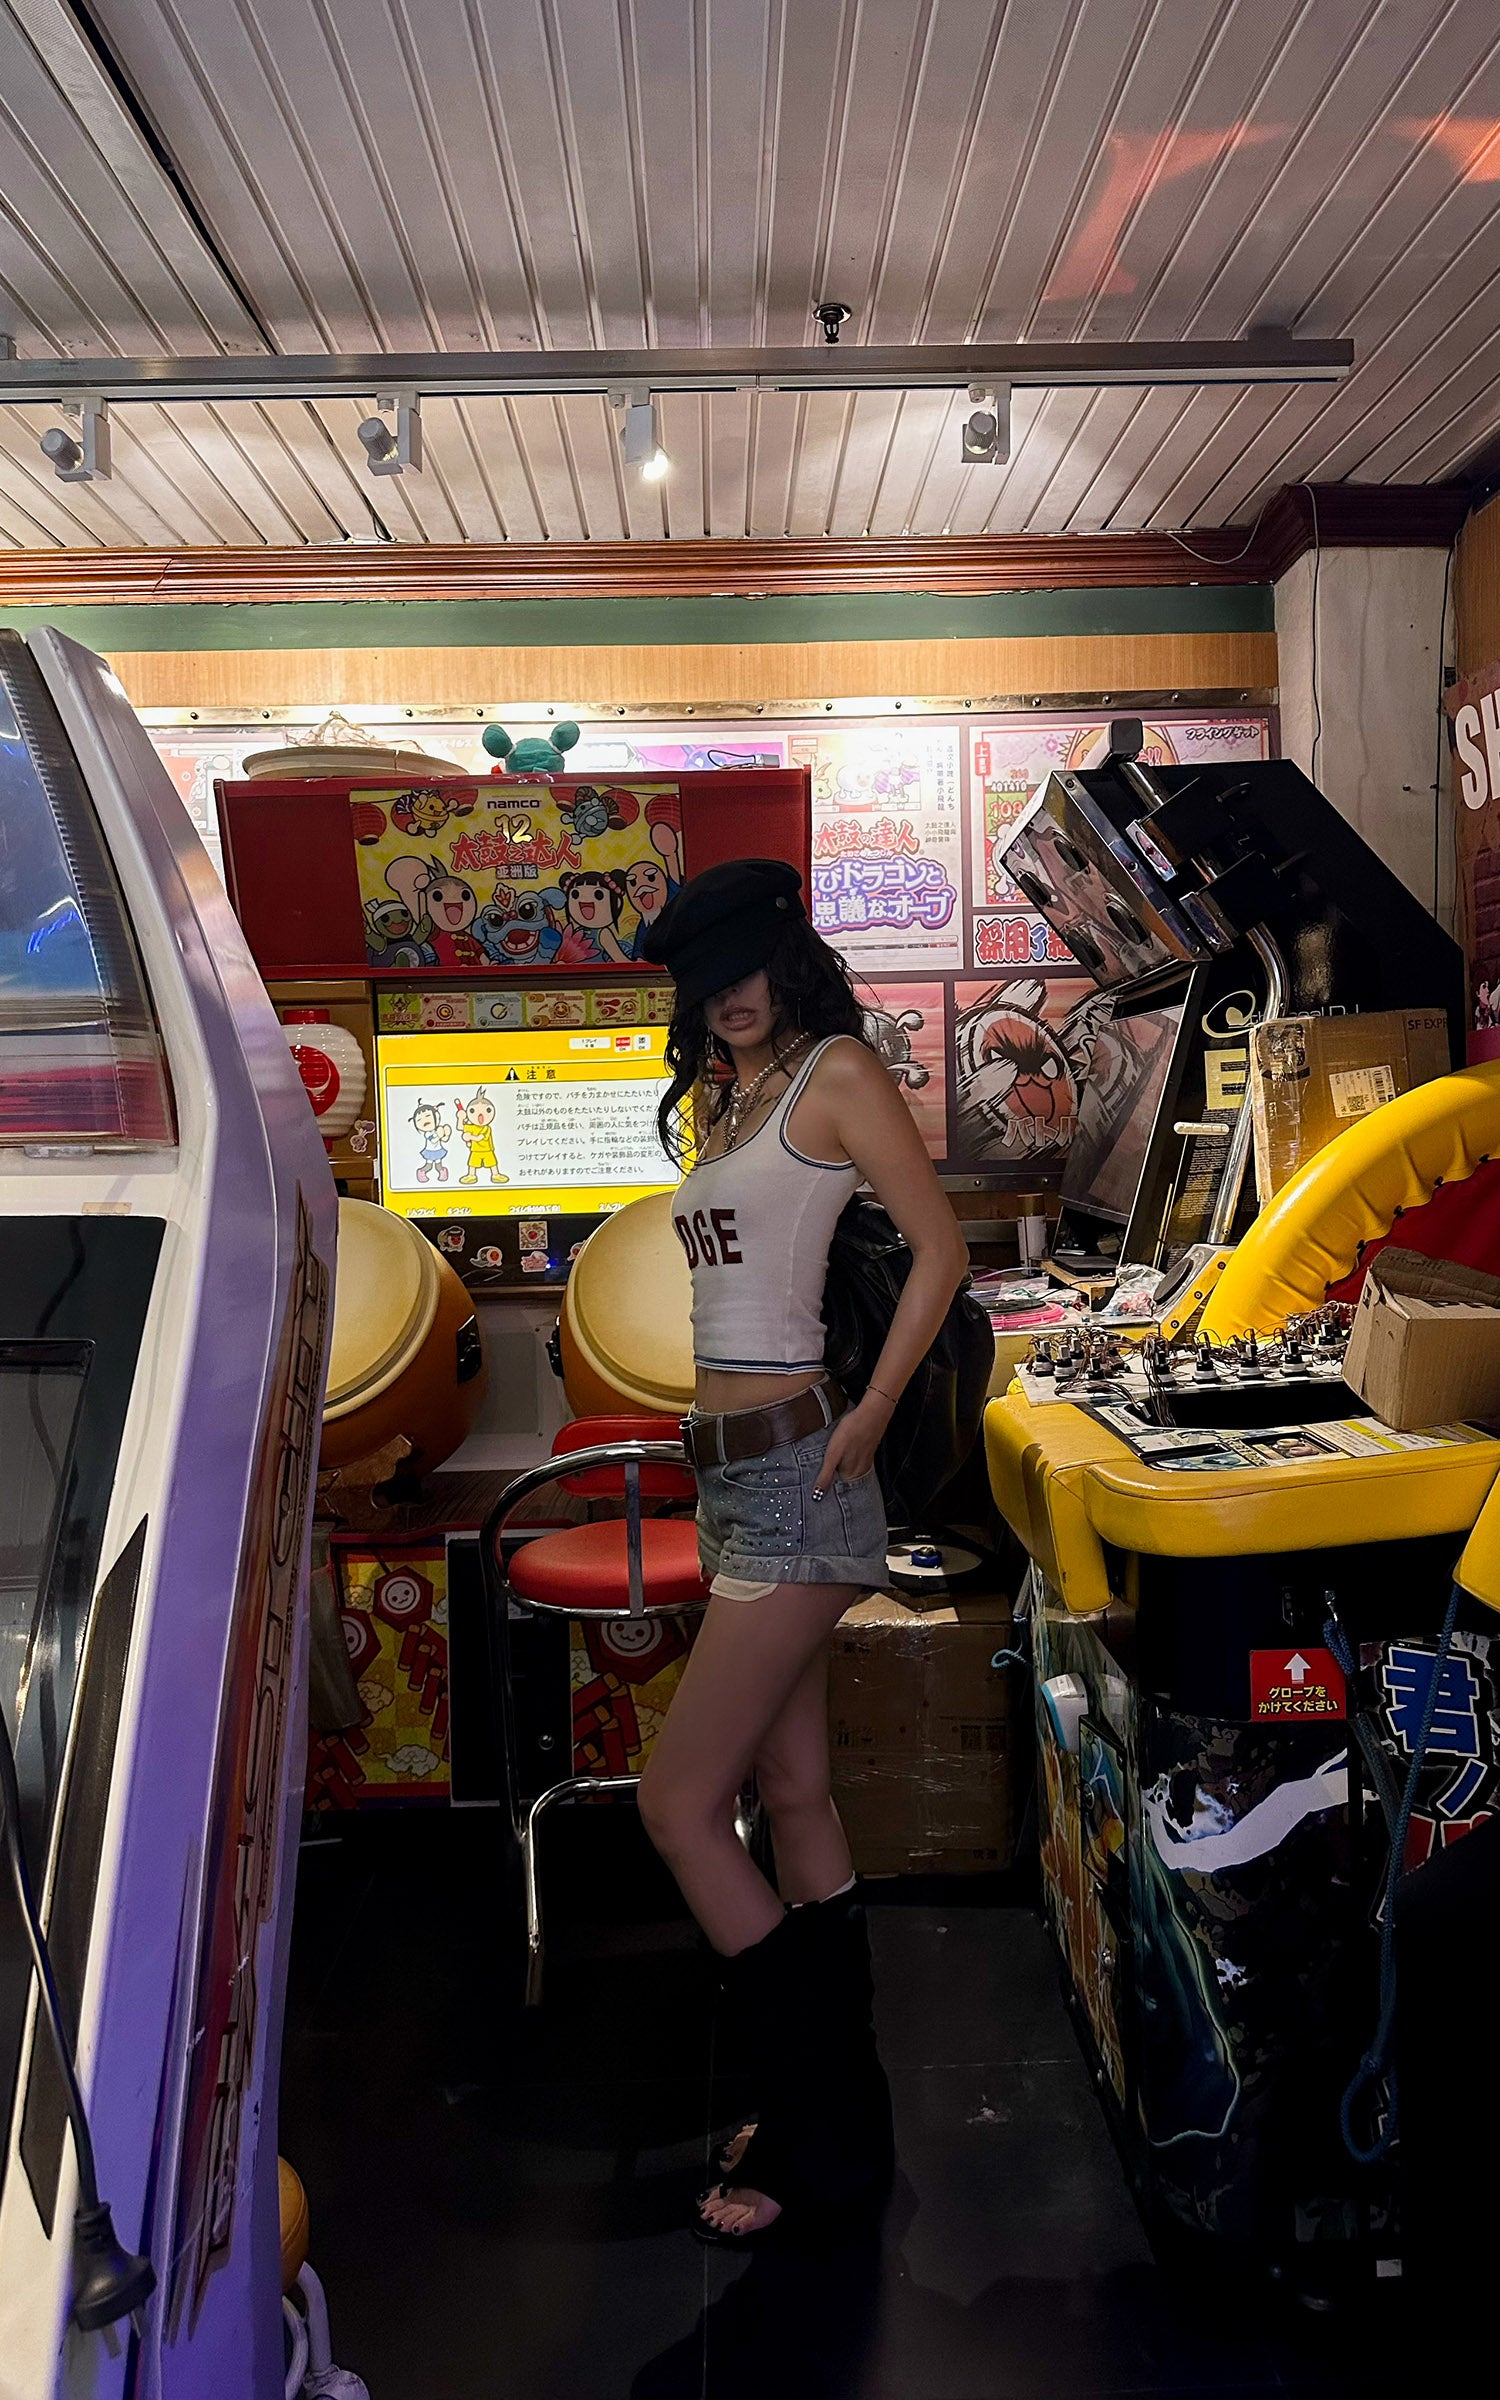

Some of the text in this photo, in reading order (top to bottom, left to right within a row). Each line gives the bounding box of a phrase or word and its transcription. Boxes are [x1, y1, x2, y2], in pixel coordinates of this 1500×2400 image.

[487, 799, 541, 809] namco
[494, 814, 535, 844] 12
[813, 817, 921, 857] 太鼓の達人
[450, 830, 582, 872] 太鼓之达人
[812, 890, 951, 927] 思議なオーブ
[1407, 1019, 1422, 1030] SF
[527, 1069, 556, 1080] 注意
[674, 1208, 744, 1270] DGE
[1269, 1685, 1327, 1699] グローブを
[1258, 1700, 1339, 1714] かけてください
